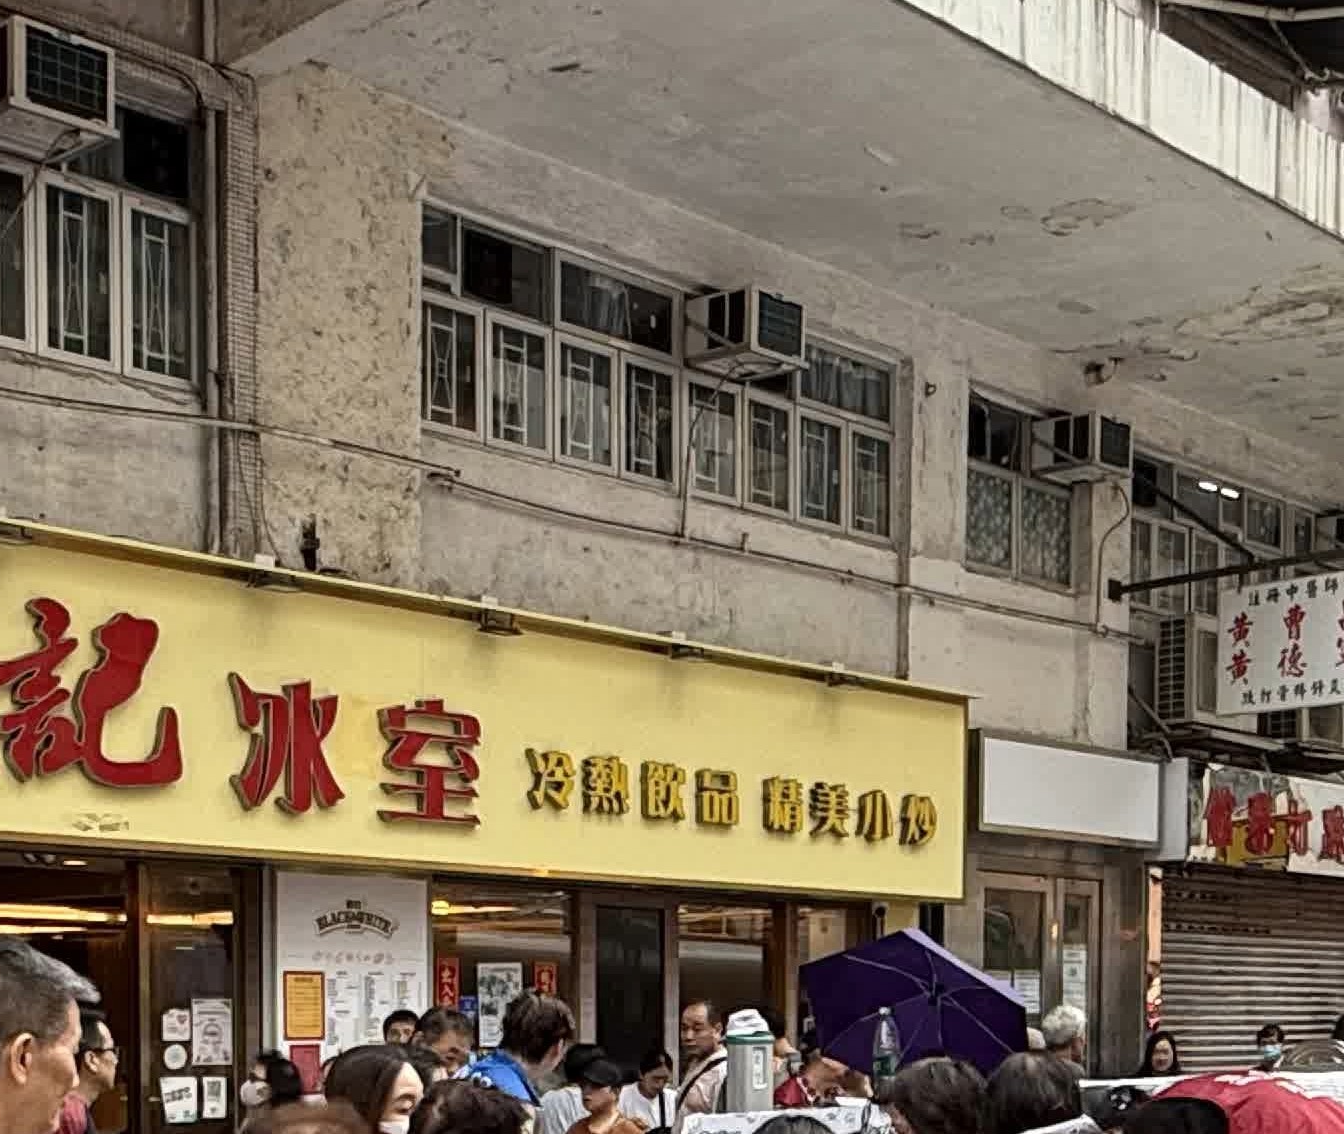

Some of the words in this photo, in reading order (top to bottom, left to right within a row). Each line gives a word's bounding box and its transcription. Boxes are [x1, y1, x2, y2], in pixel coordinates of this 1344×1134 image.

[523, 747, 741, 827] 冷熱飲品
[761, 775, 938, 846] 精美小炒
